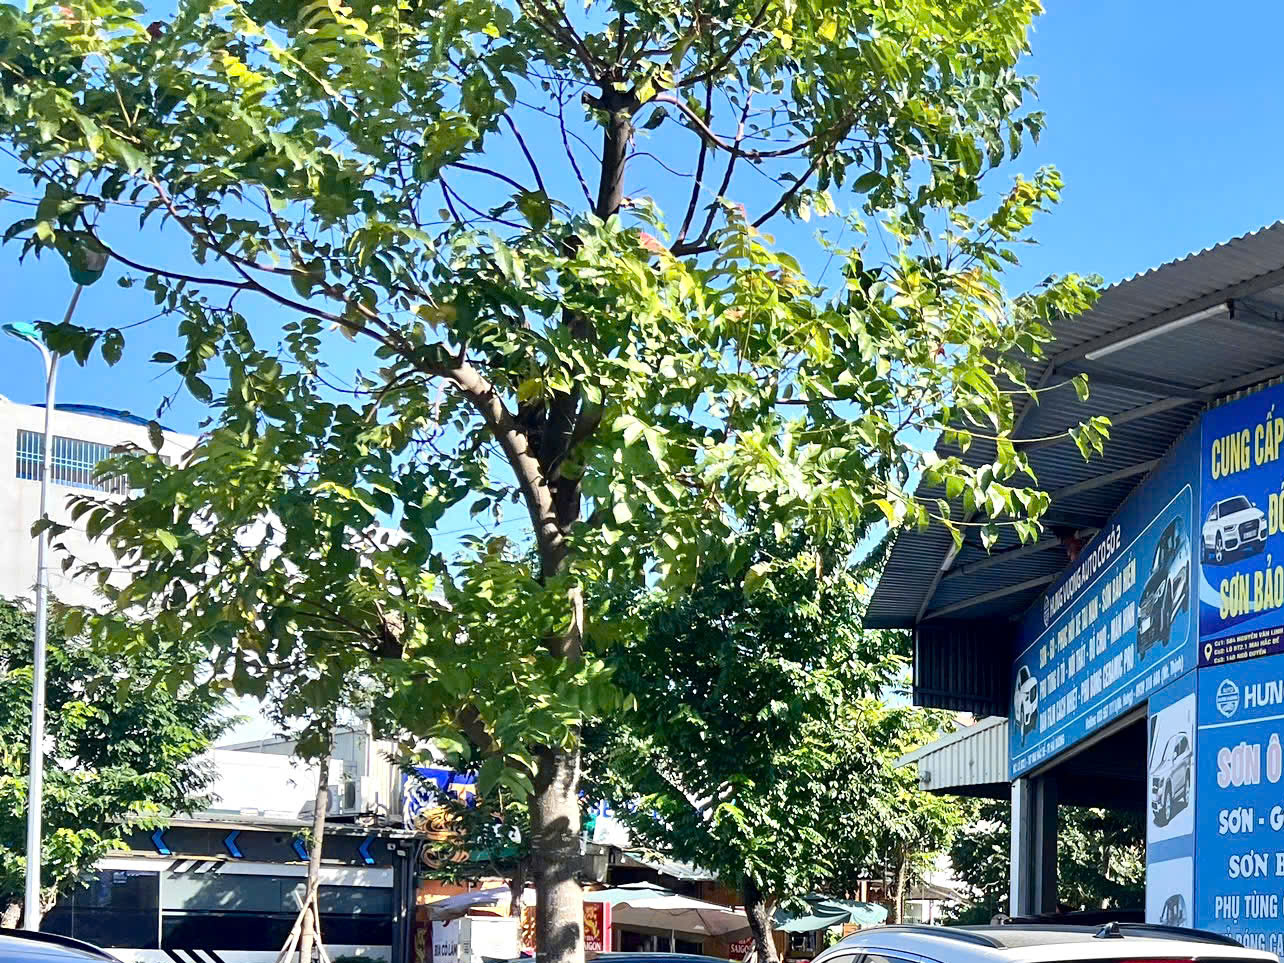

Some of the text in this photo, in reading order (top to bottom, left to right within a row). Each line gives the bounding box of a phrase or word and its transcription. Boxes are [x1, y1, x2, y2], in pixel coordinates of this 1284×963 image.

[1211, 428, 1250, 480] CUNG
[1254, 403, 1284, 466] CẤP
[1219, 571, 1250, 620] SƠN
[1253, 553, 1284, 612] BẢO
[1217, 741, 1261, 789] SƠN
[1266, 732, 1282, 783] Ô
[1218, 806, 1254, 835] SƠN
[1228, 849, 1269, 879] SƠN
[1215, 895, 1240, 924] PHỤ
[1244, 890, 1279, 919] TÙNG
